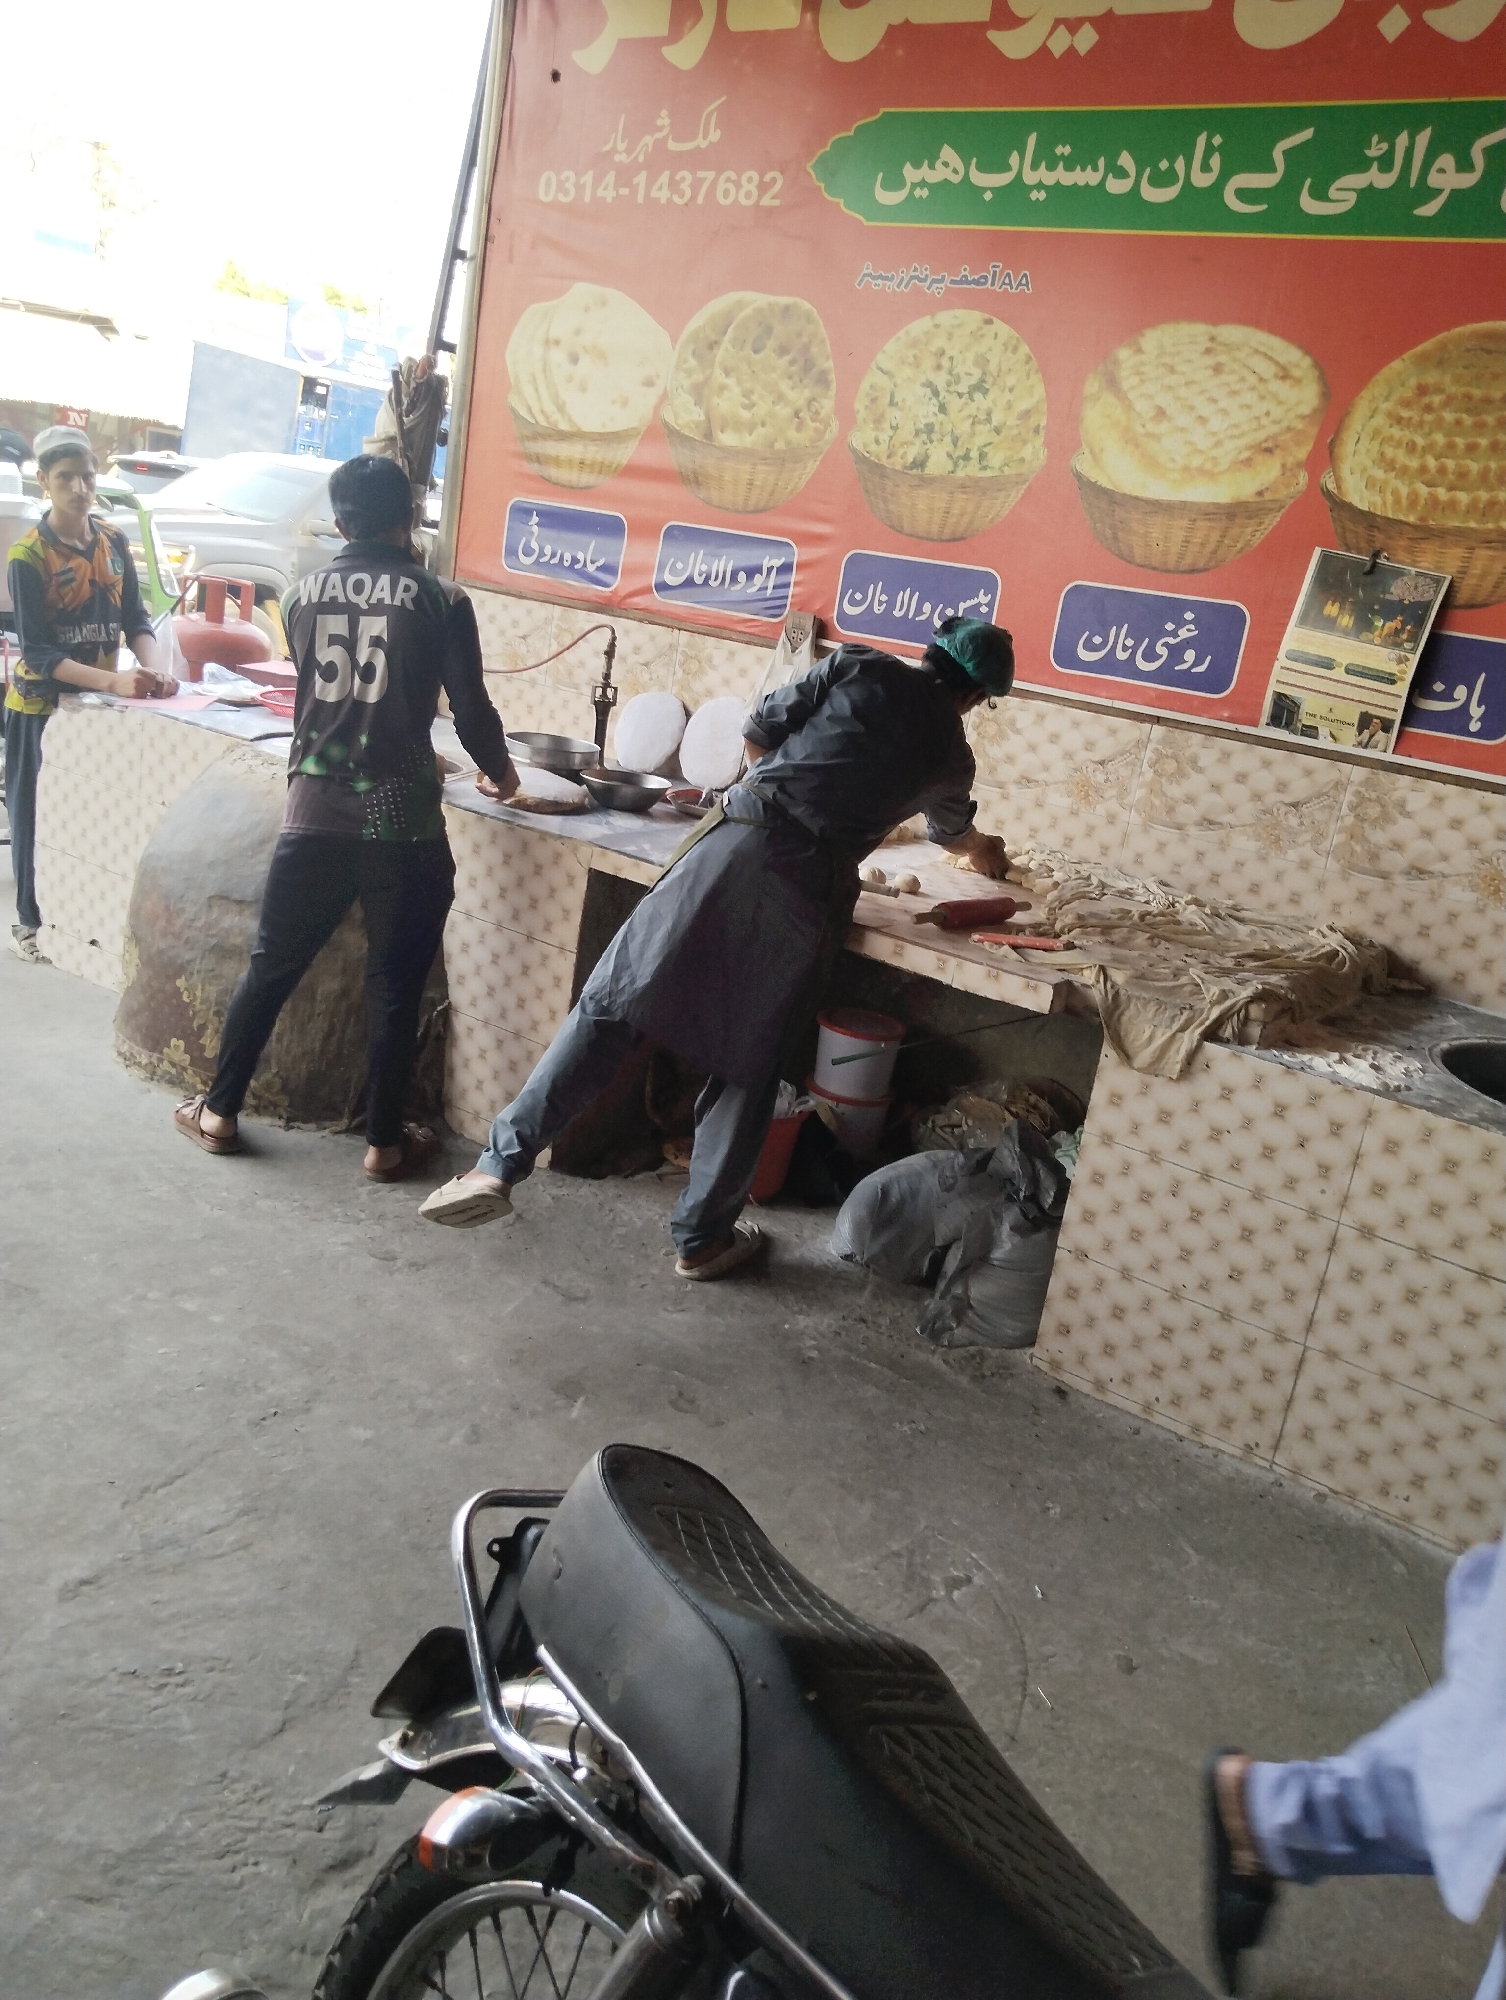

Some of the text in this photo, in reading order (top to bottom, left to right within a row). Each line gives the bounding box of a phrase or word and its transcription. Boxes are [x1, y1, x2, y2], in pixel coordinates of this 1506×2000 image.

[602, 95, 727, 163] ملک شہریار
[538, 170, 784, 206] 0314-1437682
[969, 131, 1136, 201] دستیاب
[1140, 130, 1223, 203] نان
[1223, 127, 1315, 213] کے
[947, 262, 1002, 289] آصف
[518, 510, 606, 572] سادہ روٹی
[664, 550, 708, 586] نان
[300, 572, 419, 610] WAQAR
[746, 555, 785, 596] آلو
[843, 580, 889, 616] نان
[315, 614, 389, 703] 55
[1077, 611, 1212, 672] روغنی نان
